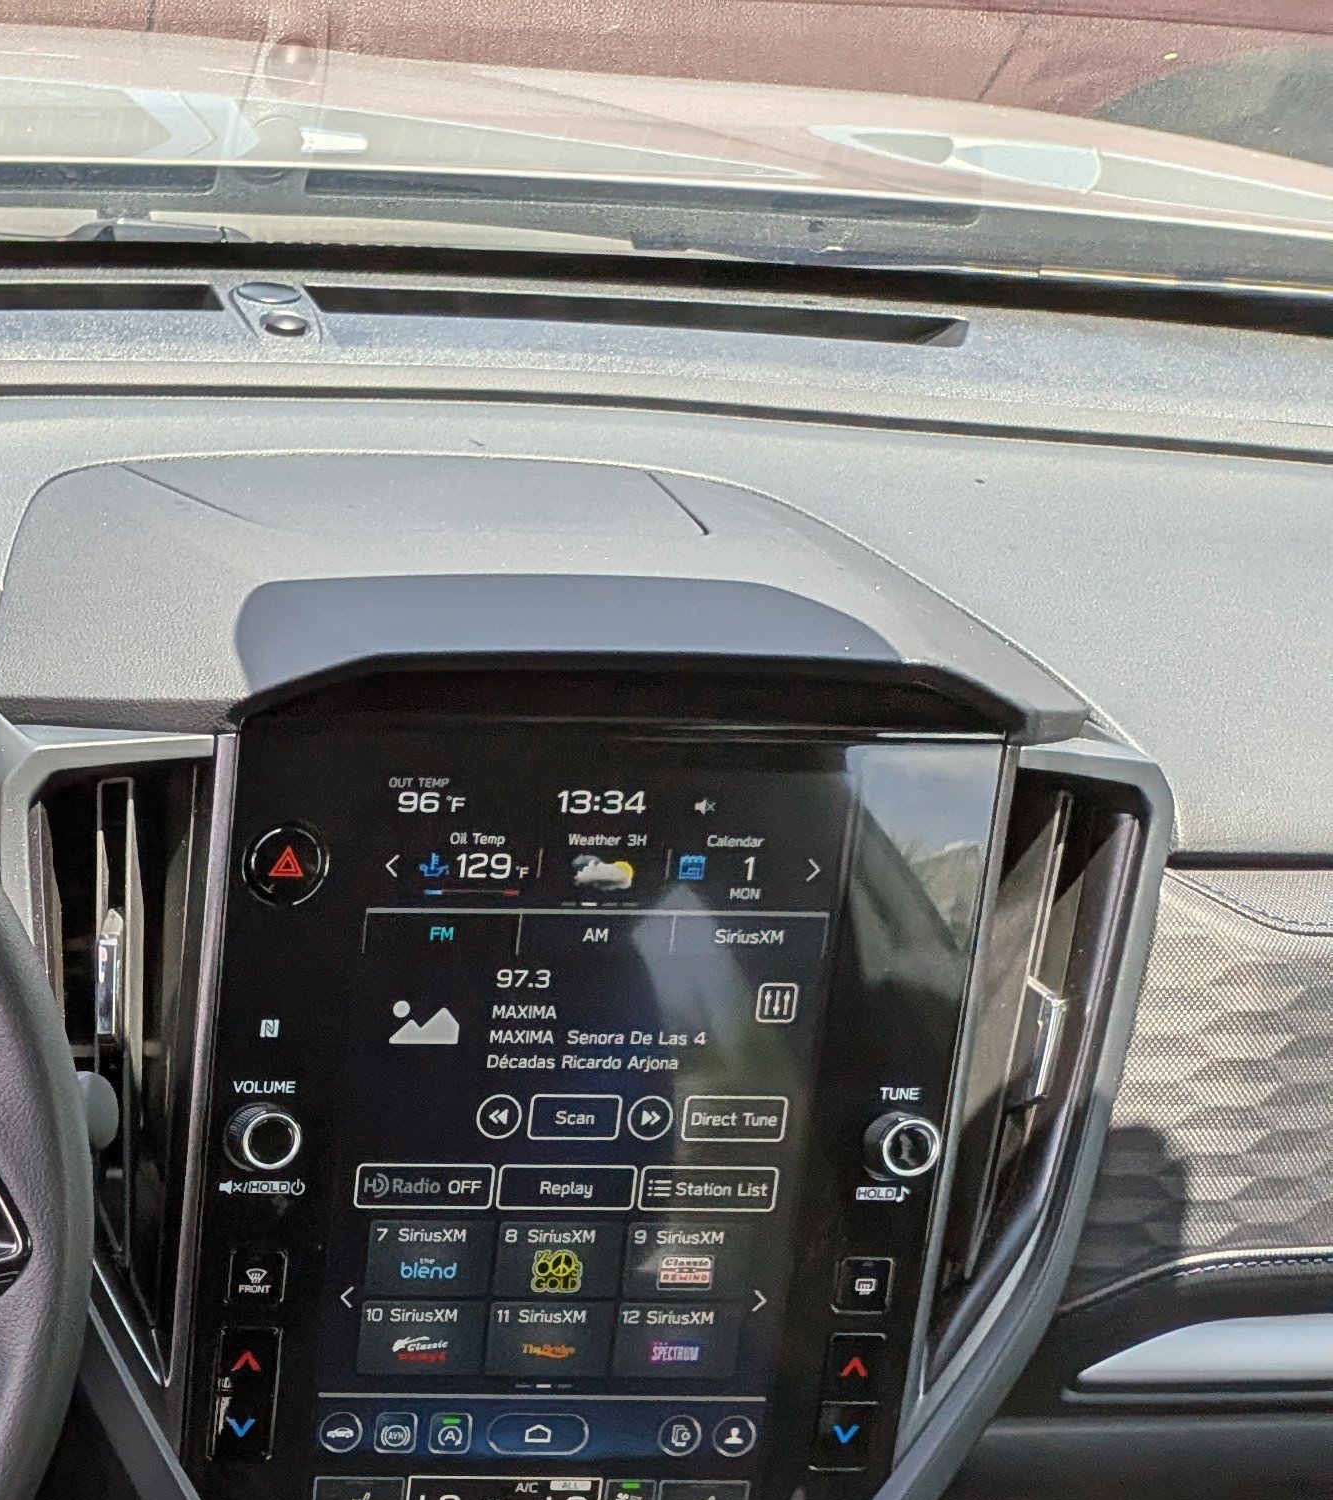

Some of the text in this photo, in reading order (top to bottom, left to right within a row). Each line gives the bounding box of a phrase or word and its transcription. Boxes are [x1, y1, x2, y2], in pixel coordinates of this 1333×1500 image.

[389, 777, 450, 788] OUT TEMP
[397, 791, 441, 813] 96
[557, 790, 646, 815] 13:34
[450, 832, 506, 847] Oil Temp
[568, 834, 648, 847] Weather 3H
[707, 835, 765, 848] Calendar
[456, 853, 512, 879] 129
[744, 857, 756, 882] 1
[730, 888, 761, 900] MON
[429, 926, 454, 941] FM
[583, 928, 609, 943] AM
[714, 929, 784, 945] SiriusXM
[496, 969, 552, 989] 97.3
[491, 1005, 557, 1020] MAXIMA
[489, 1029, 708, 1046] MAXIMA Senora De Las 4
[486, 1053, 680, 1073] Décadas Ricardo Arjona
[233, 1081, 296, 1093] VOLUME
[880, 1087, 920, 1100] TUNE
[555, 1110, 595, 1126] Scan
[691, 1111, 778, 1127] Direct Tune
[250, 1182, 288, 1193] HOLD
[393, 1177, 441, 1194] Radio
[448, 1180, 483, 1195] OFF
[540, 1180, 593, 1198] Replay
[675, 1182, 768, 1197] Station List
[857, 1189, 895, 1199] HOLD
[376, 1227, 467, 1243] 7 SiriusXM
[505, 1229, 596, 1244] 8 SiriusXM
[634, 1230, 725, 1245] 9 SiriusXM
[400, 1262, 457, 1279] blend
[238, 1284, 271, 1294] FRONT
[531, 1277, 581, 1293] GOLD
[366, 1308, 458, 1323] 10 SiriusXM
[497, 1310, 587, 1324] 11 SiriusXM
[622, 1310, 714, 1325] 12 SiriusXM
[515, 1482, 539, 1494] A/C
